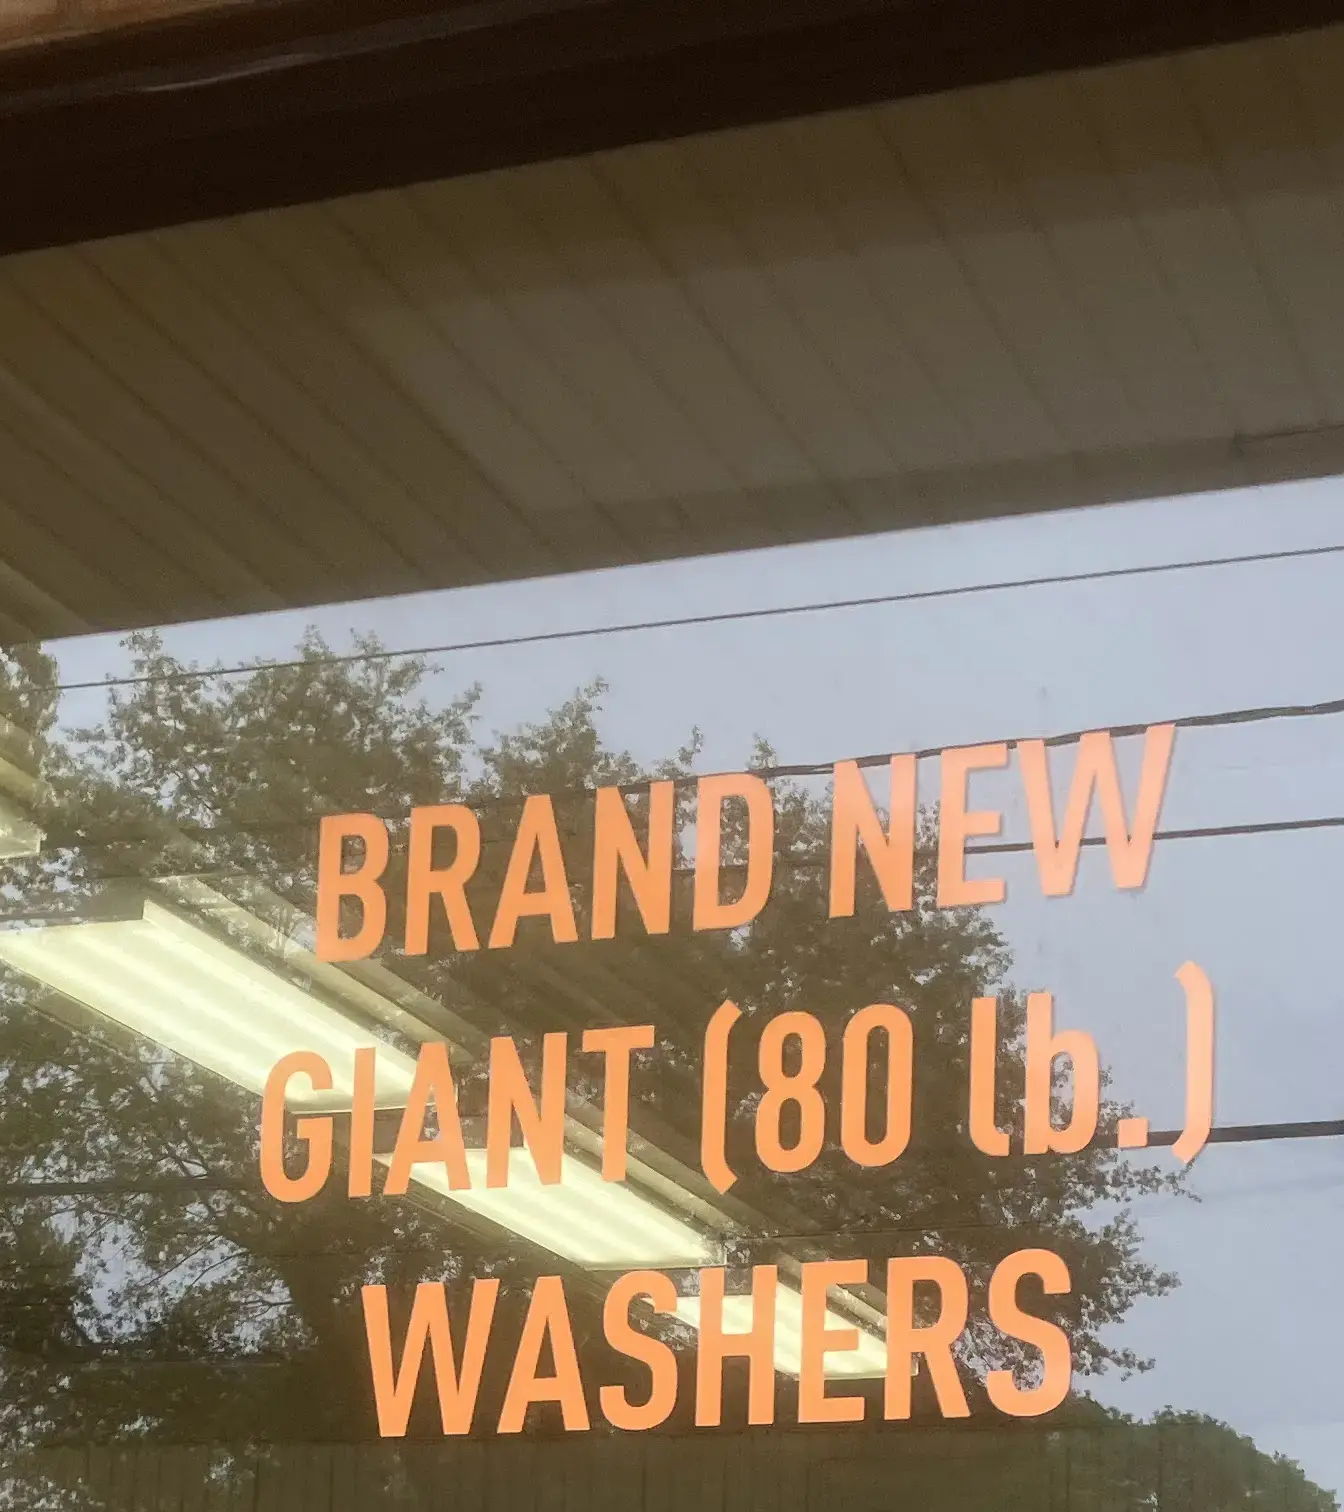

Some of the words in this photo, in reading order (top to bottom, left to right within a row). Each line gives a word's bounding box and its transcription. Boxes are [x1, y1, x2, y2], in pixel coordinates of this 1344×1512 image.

[315, 774, 775, 963] BRAND
[828, 724, 1174, 920] NEW
[259, 1024, 656, 1204] GIANT
[700, 999, 915, 1194] (80
[968, 960, 1214, 1165] lb.)
[360, 1247, 1073, 1439] WASHERS
